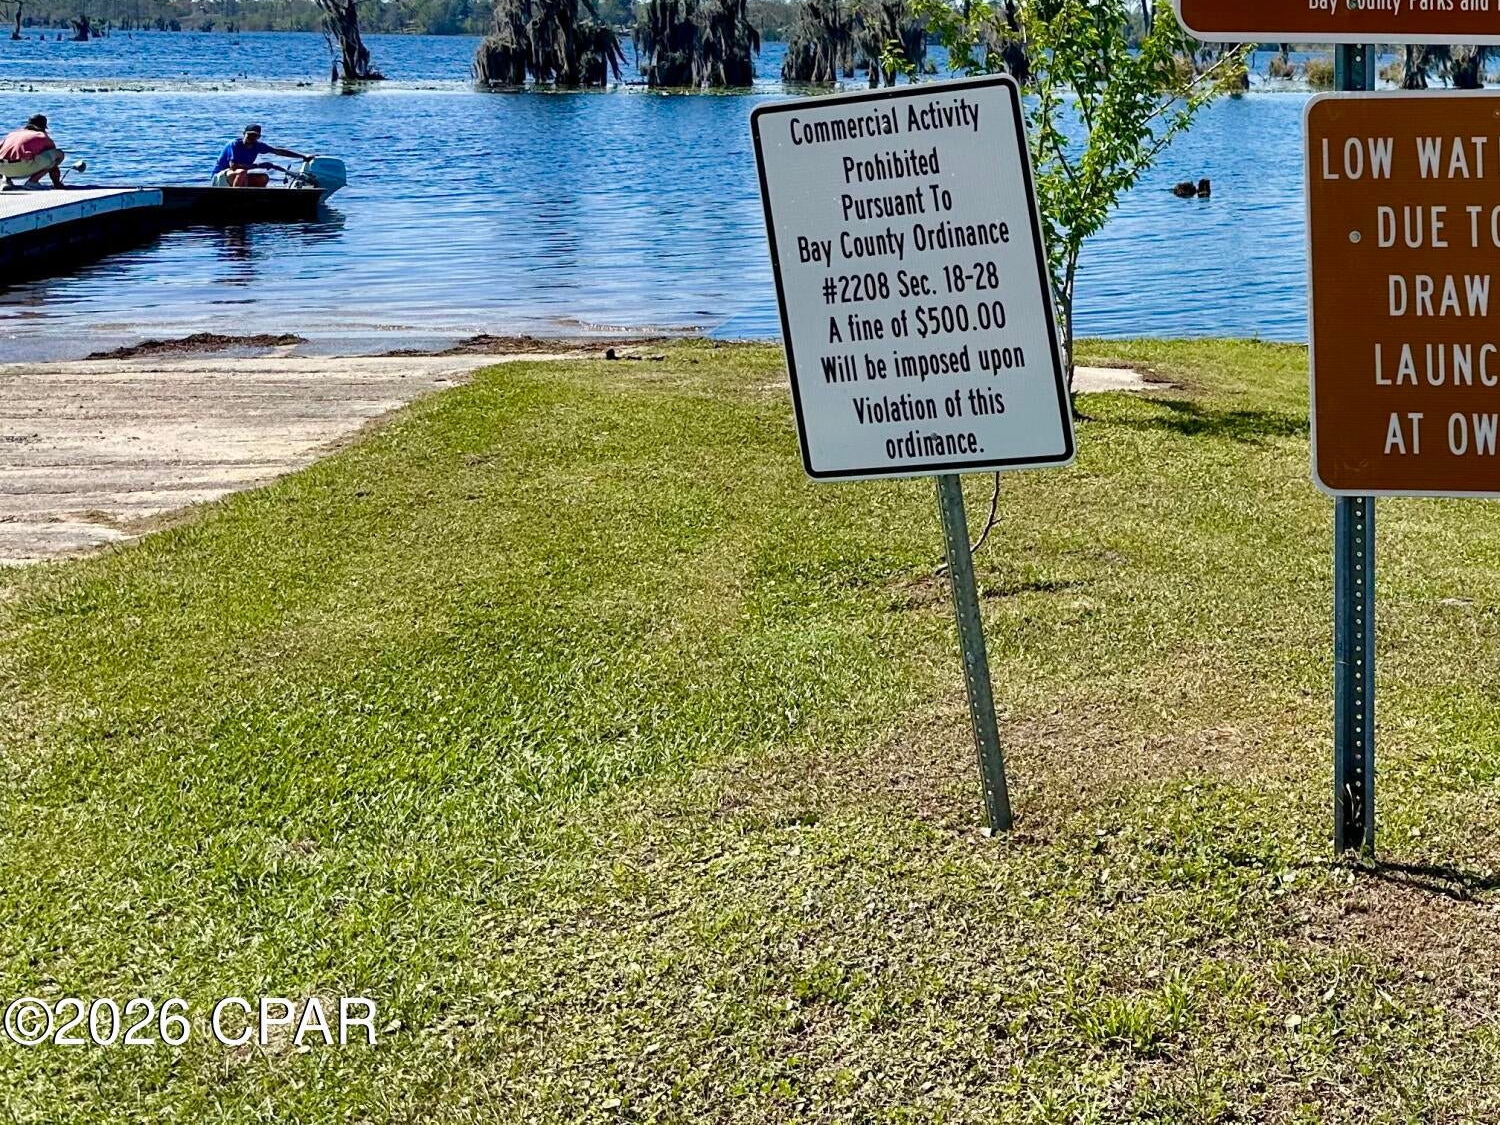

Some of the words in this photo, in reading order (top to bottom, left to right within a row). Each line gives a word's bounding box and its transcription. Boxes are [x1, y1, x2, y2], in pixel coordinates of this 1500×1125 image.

[790, 107, 899, 146] Commercial
[908, 99, 978, 132] Activity
[843, 147, 939, 183] Prohibited
[1323, 138, 1393, 179] LOW
[842, 187, 925, 221] Pursuant
[929, 185, 952, 211] To
[798, 236, 831, 267] Bay
[841, 227, 904, 260] County
[913, 221, 1009, 251] Ordinance
[1378, 206, 1448, 248] DUE
[823, 272, 889, 304] #2208
[897, 270, 936, 297] Sec.
[943, 262, 999, 292] 18-28
[1389, 275, 1490, 316] DRAW
[830, 317, 842, 343] A
[848, 314, 883, 341] fine
[891, 310, 908, 337] of
[916, 301, 1005, 338] $500.00
[821, 355, 857, 383] Will
[865, 354, 886, 380] be
[894, 345, 970, 382] imposed
[979, 347, 1025, 376] upon
[853, 394, 937, 424] Violation
[945, 390, 962, 417] of
[968, 387, 1005, 415] this
[886, 430, 985, 459] ordinance.
[1384, 413, 1423, 454] AT
